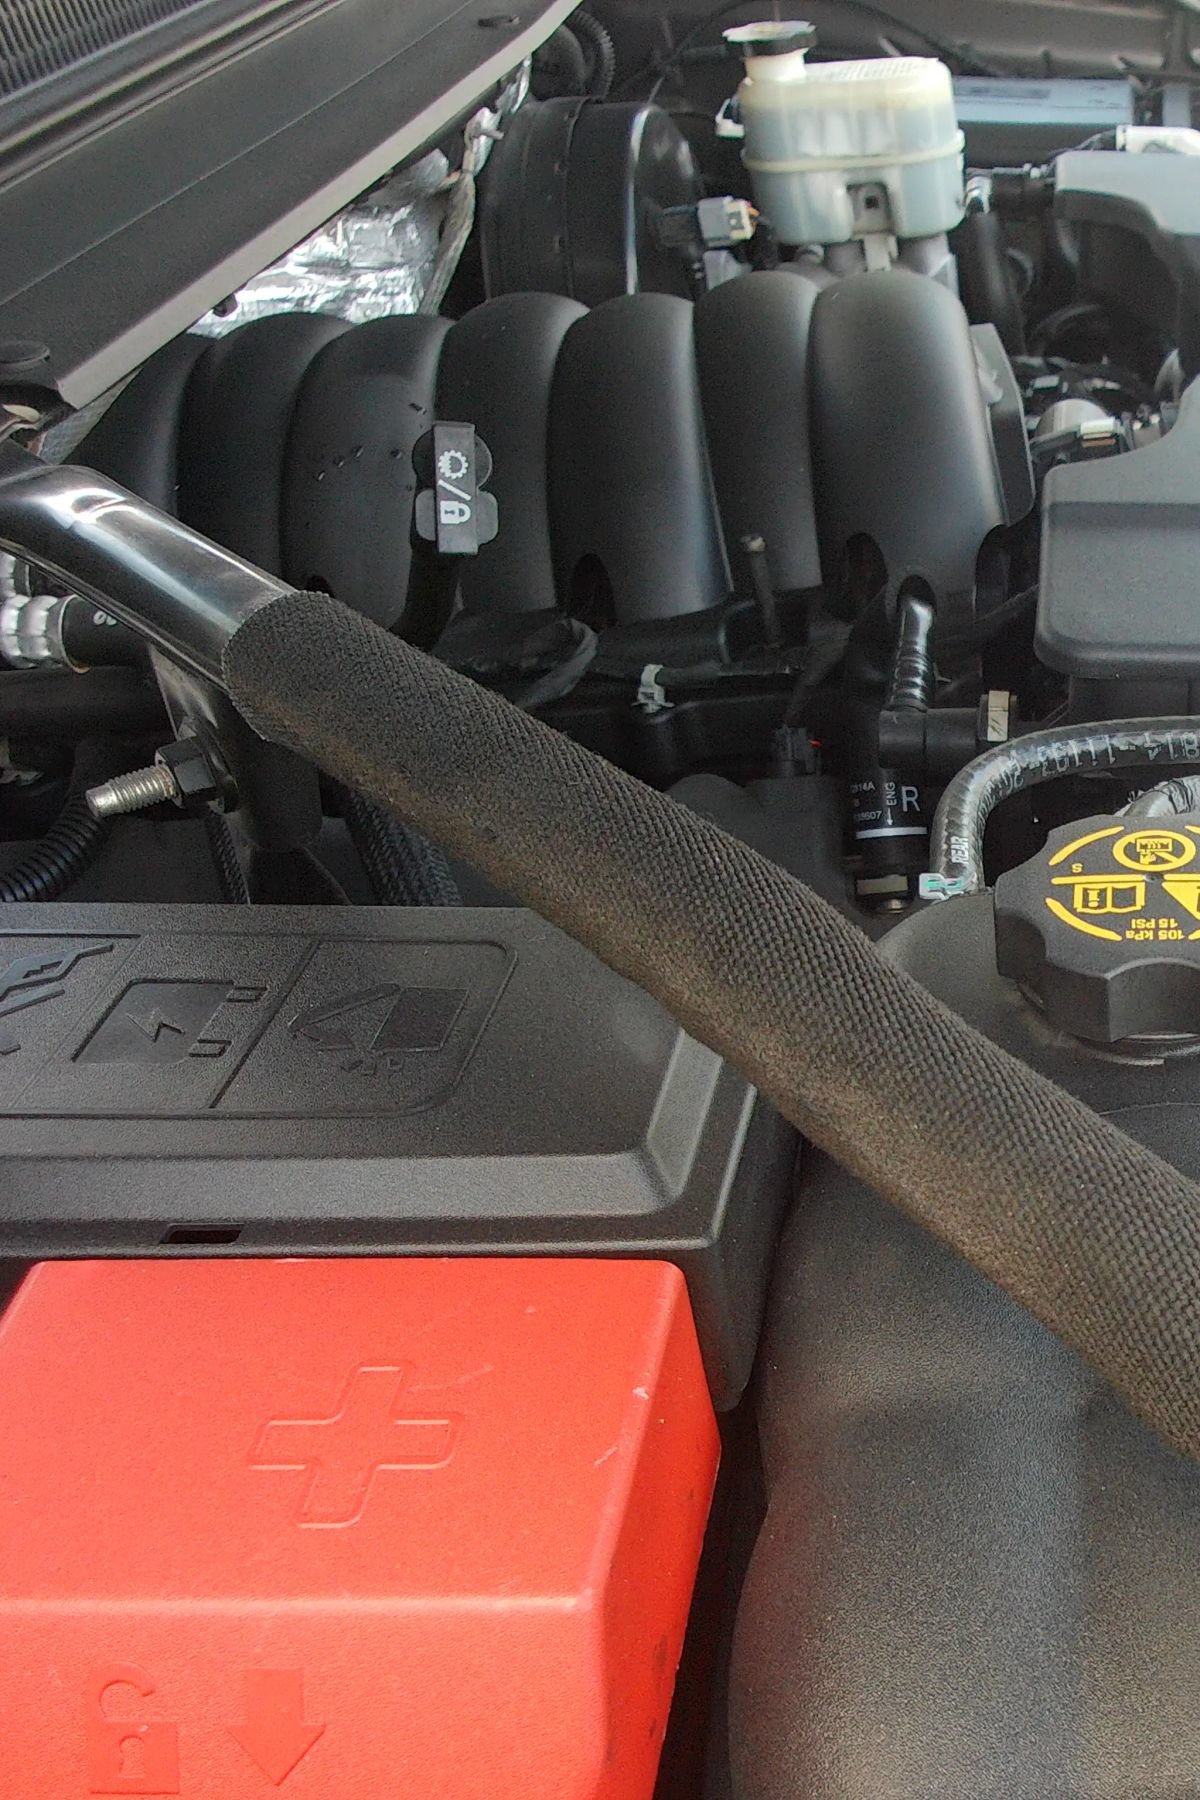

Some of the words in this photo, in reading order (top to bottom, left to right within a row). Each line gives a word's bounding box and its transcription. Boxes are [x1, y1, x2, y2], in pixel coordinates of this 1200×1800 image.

[885, 782, 897, 806] ENG
[901, 785, 921, 812] R
[950, 835, 970, 864] REAR
[1131, 918, 1156, 928] PSI
[1158, 918, 1179, 928] 15
[1125, 929, 1154, 940] kPa
[1158, 929, 1185, 940] 105
